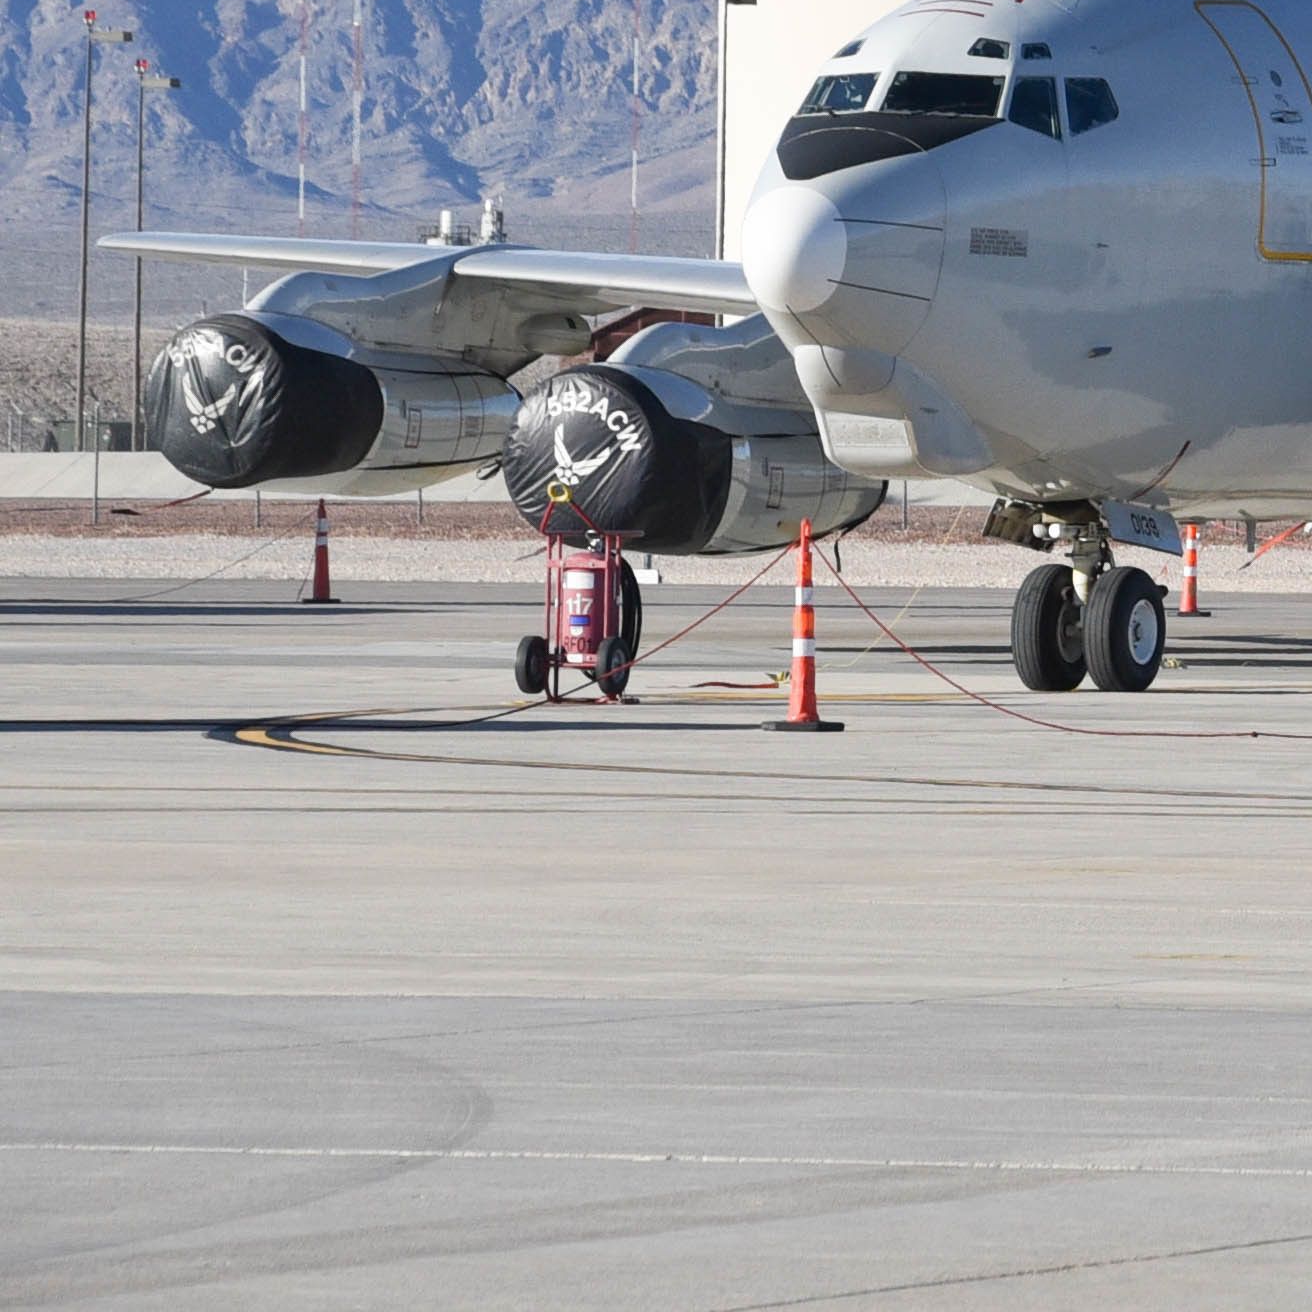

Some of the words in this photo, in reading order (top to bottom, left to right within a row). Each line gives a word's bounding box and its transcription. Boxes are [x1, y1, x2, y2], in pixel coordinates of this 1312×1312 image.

[547, 390, 642, 452] 552ACW
[1130, 512, 1160, 538] 0139
[566, 594, 594, 615] 117
